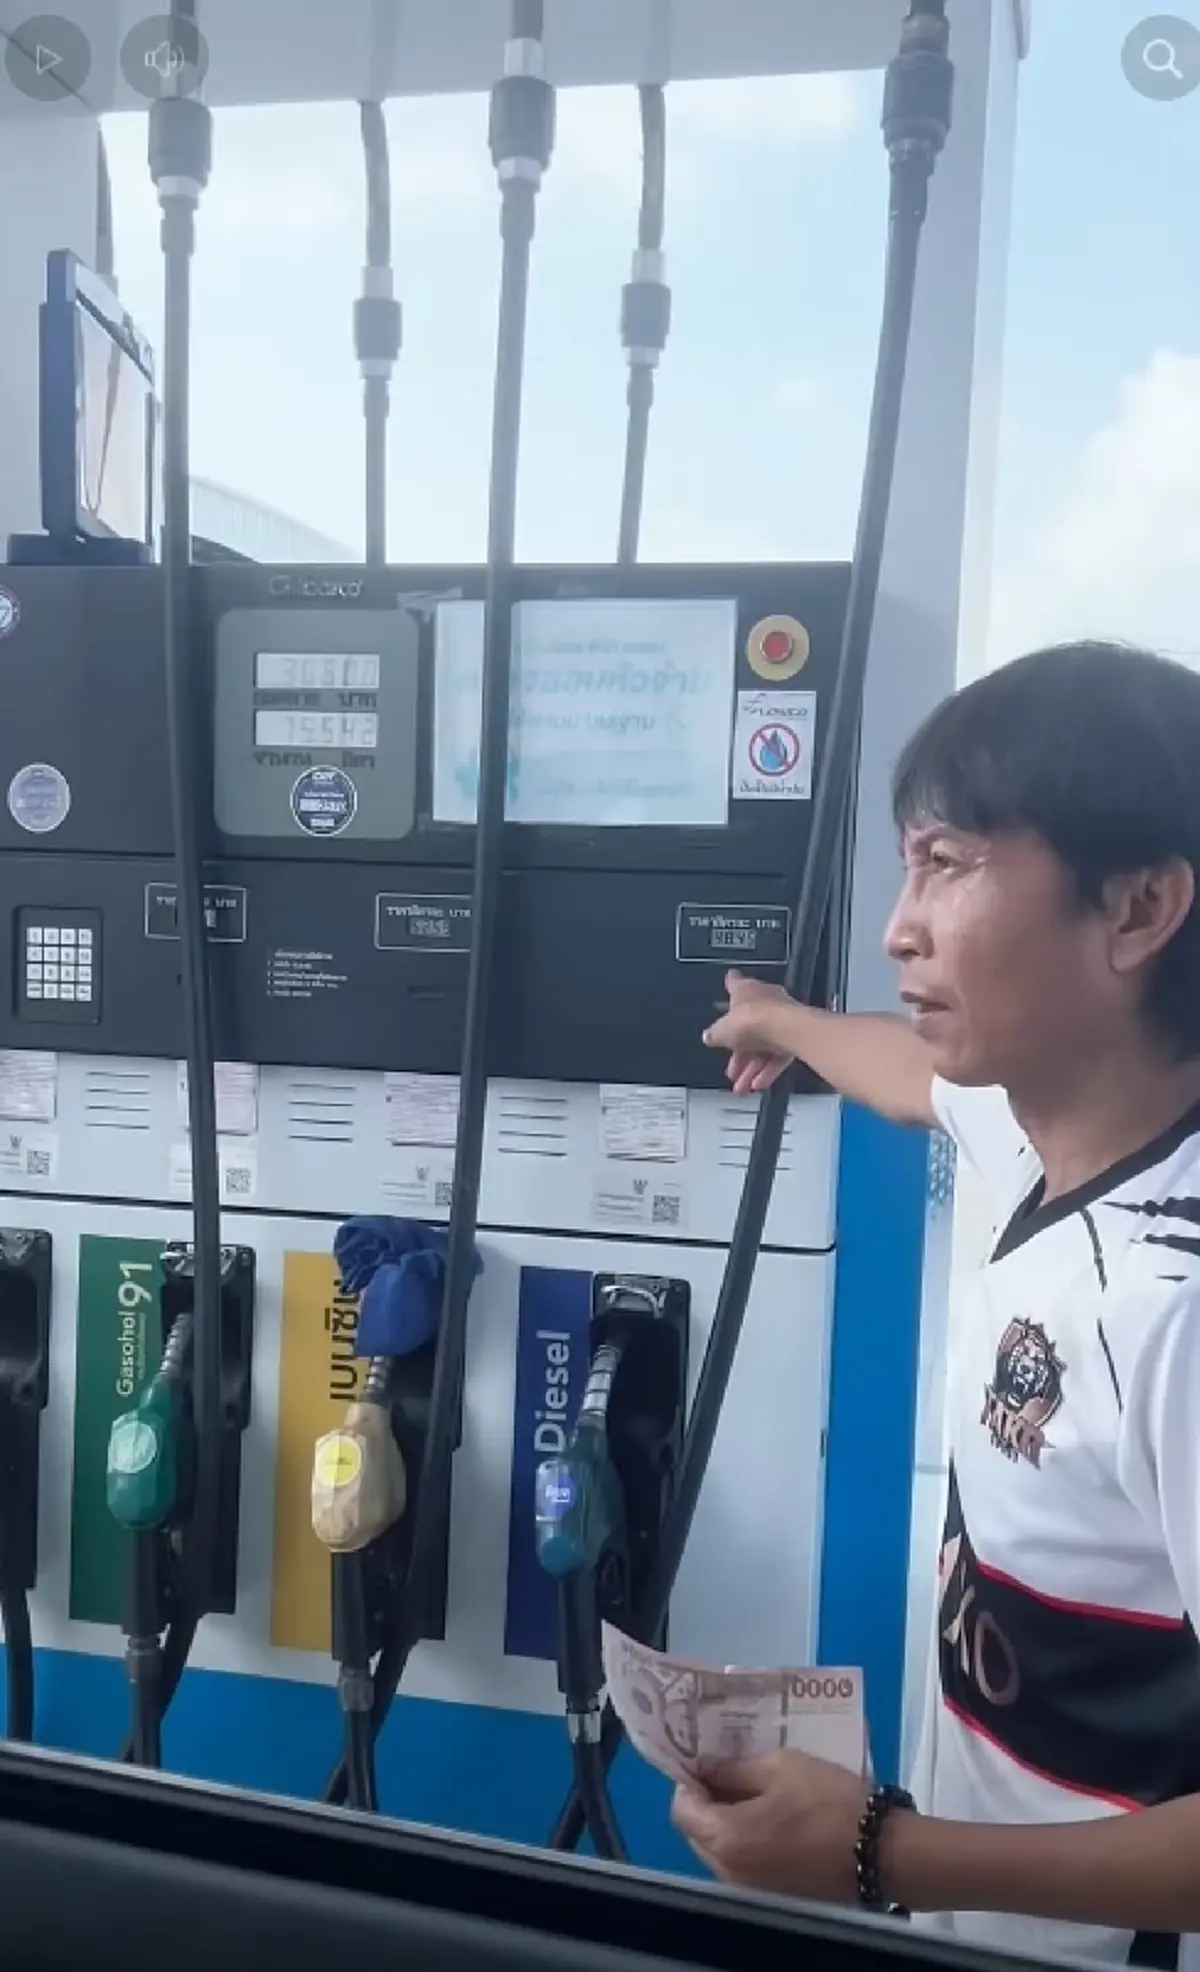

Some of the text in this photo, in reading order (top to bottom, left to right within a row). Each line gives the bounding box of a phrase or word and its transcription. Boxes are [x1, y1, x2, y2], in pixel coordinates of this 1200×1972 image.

[116, 1262, 152, 1397] Gasohol 91
[534, 1330, 571, 1452] Diesel
